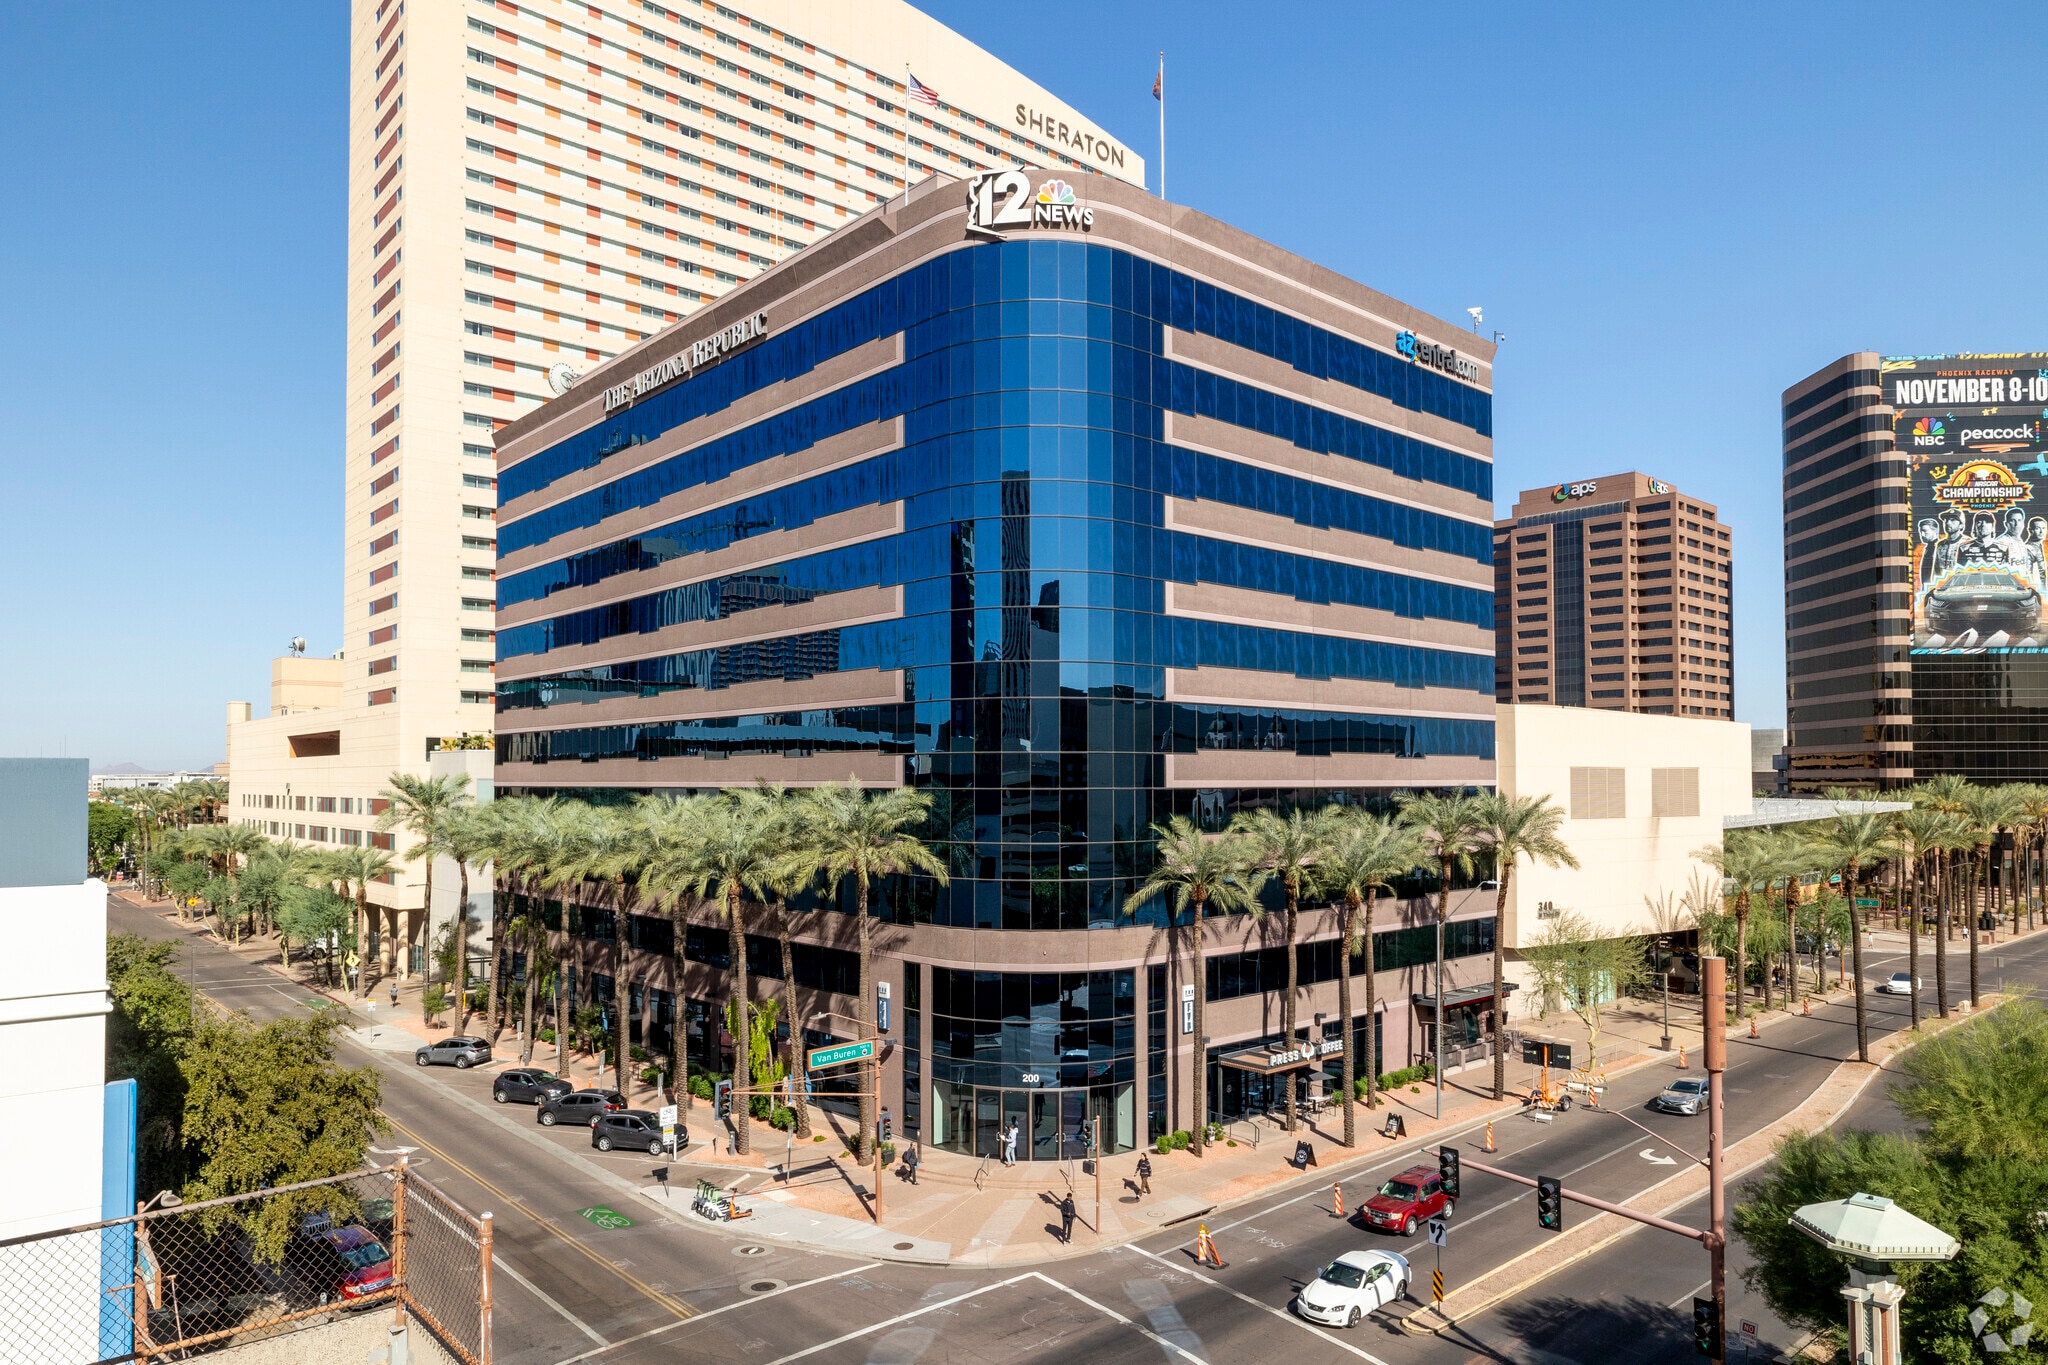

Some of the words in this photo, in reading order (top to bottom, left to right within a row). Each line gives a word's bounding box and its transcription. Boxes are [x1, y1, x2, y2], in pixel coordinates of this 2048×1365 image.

[1015, 103, 1124, 169] SHERATON
[979, 170, 1032, 226] 12
[1035, 204, 1094, 226] NEWS
[603, 383, 631, 412] THE
[632, 353, 692, 399] ARIZONA
[692, 310, 768, 368] REPUBLIC
[1896, 377, 2005, 404] NOVEMBER
[2009, 376, 2048, 402] 8-10
[1914, 435, 1945, 446] NBC
[1960, 423, 2034, 446] peacock
[1570, 481, 1597, 497] aps
[1656, 481, 1669, 495] aps
[1943, 487, 2023, 498] CHAMPIONSHIP
[817, 1054, 832, 1063] Van
[833, 1050, 856, 1060] Buren
[1269, 1050, 1299, 1066] PRESS
[1022, 1074, 1040, 1083] 200
[1744, 1324, 1754, 1333] NO
